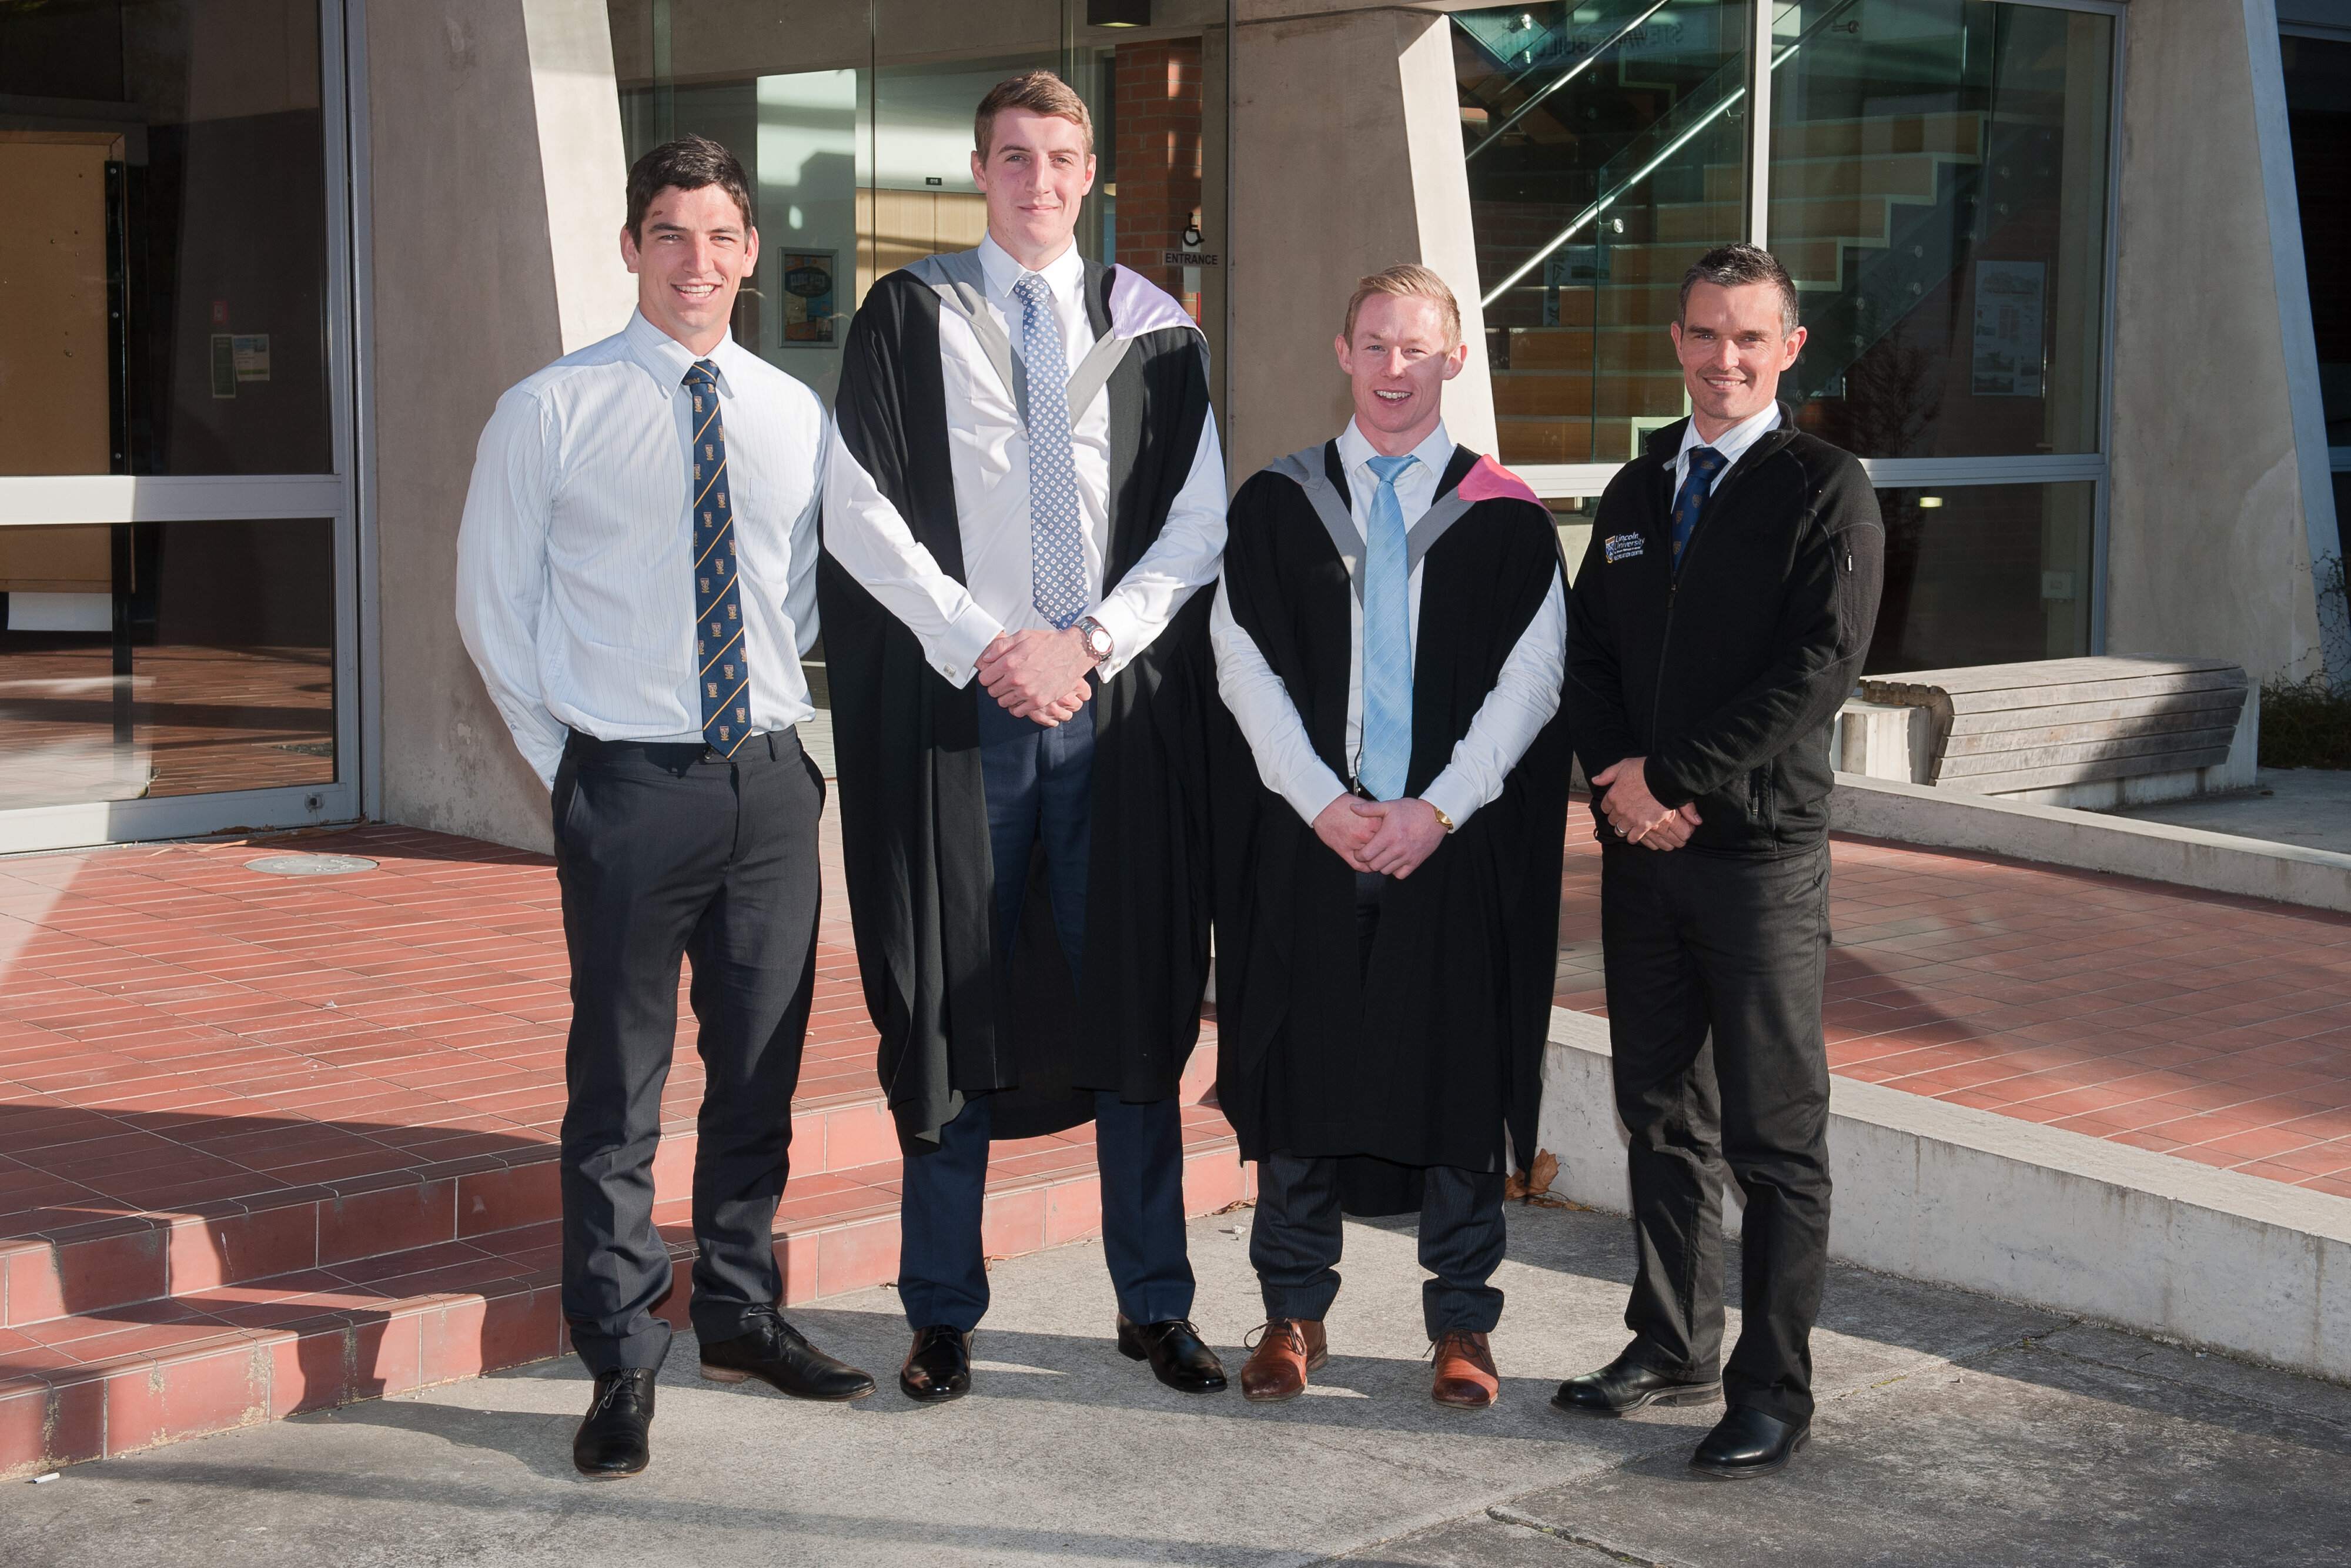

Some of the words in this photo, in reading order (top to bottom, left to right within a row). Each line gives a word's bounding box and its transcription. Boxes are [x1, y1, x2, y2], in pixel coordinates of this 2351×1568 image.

[1165, 253, 1218, 265] ENTRANCE
[1615, 531, 1639, 543] Lincoln
[1614, 537, 1645, 550] University
